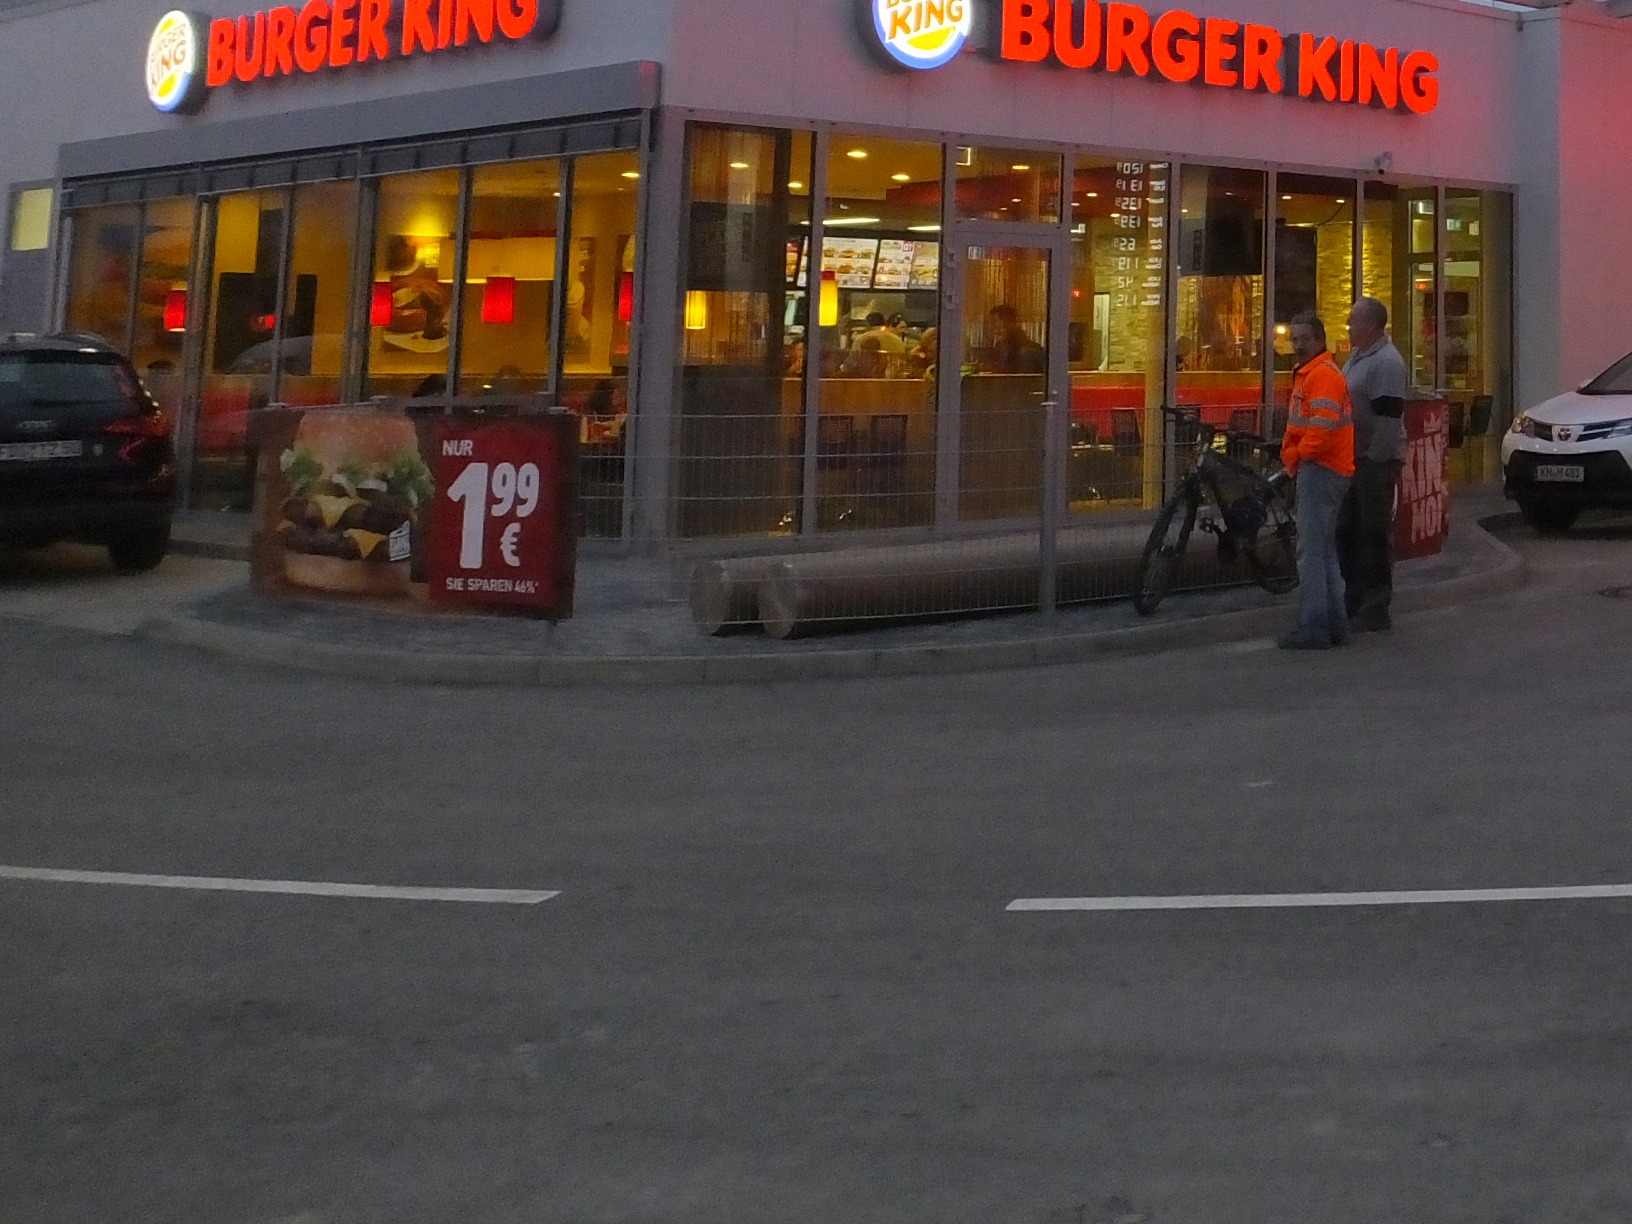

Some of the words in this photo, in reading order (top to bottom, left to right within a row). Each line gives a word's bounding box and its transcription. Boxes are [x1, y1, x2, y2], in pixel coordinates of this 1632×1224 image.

[1298, 32, 1440, 116] KING
[442, 440, 474, 456] NUR
[446, 577, 464, 591] SIE
[467, 578, 513, 592] SPAREN
